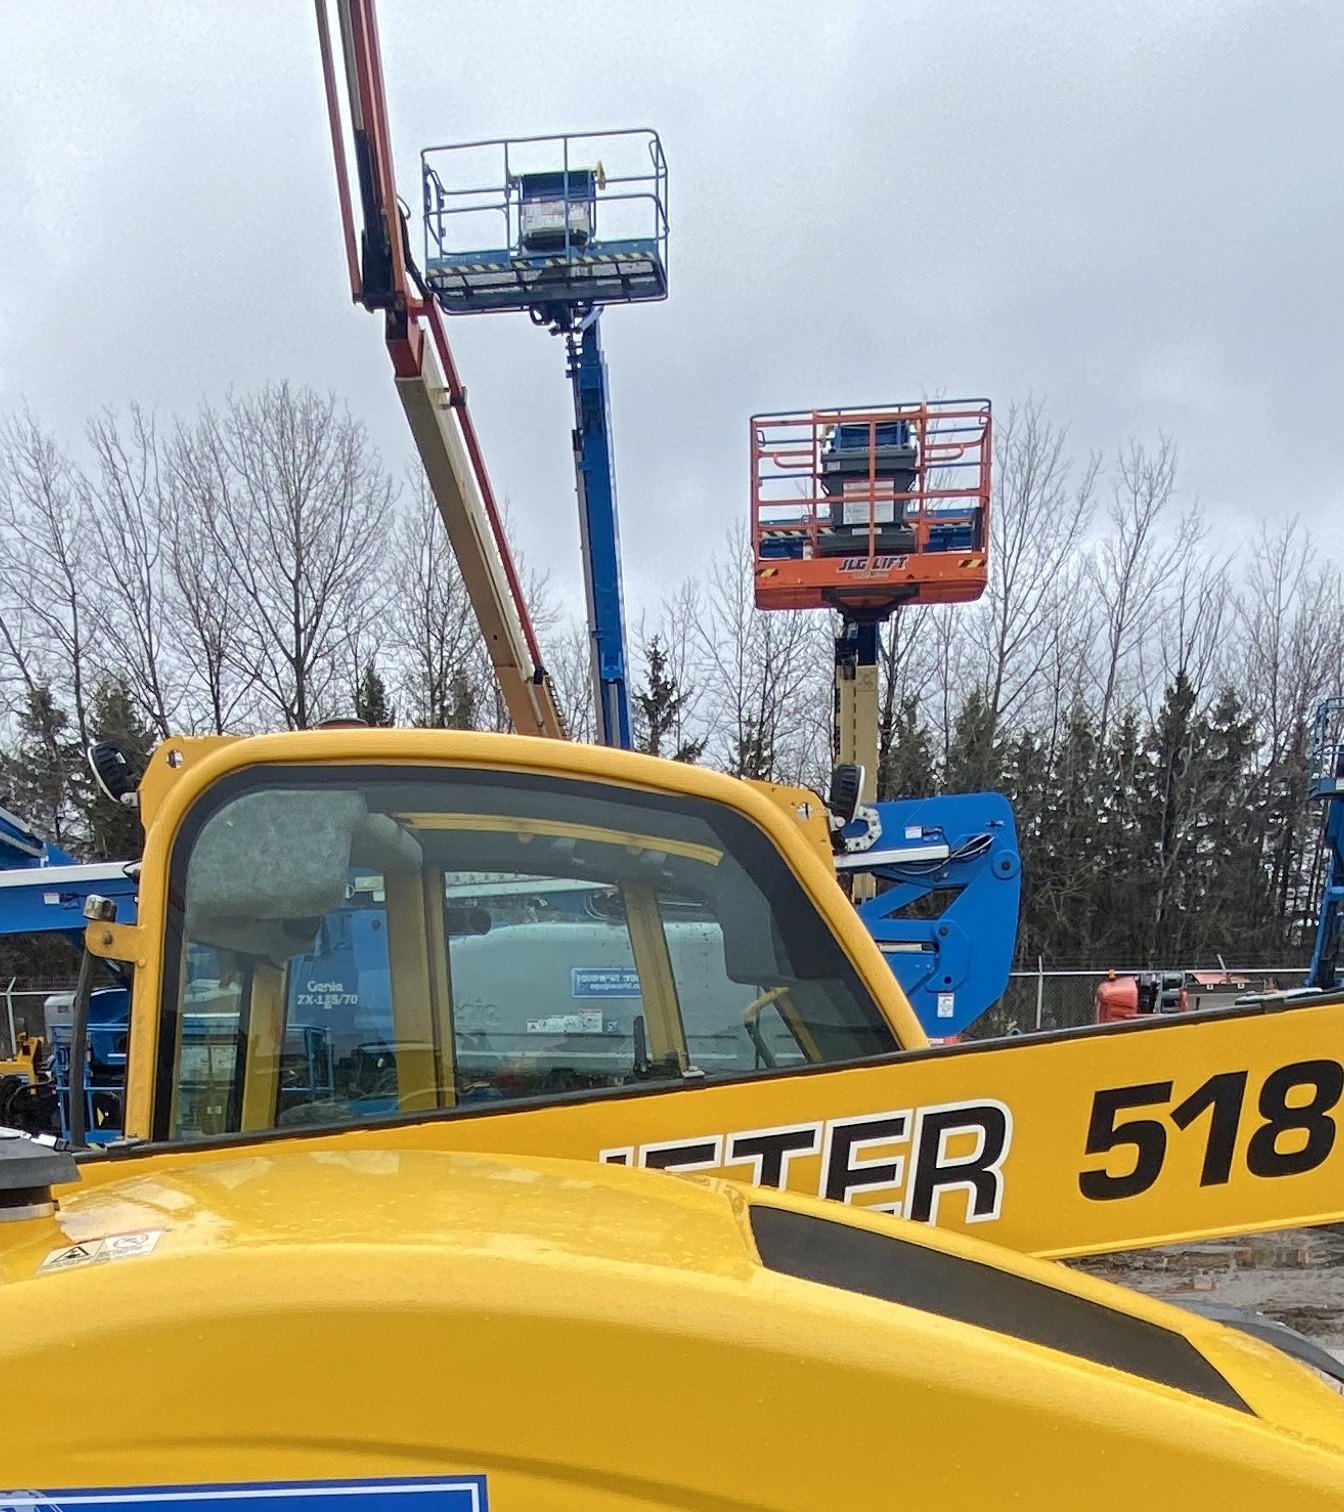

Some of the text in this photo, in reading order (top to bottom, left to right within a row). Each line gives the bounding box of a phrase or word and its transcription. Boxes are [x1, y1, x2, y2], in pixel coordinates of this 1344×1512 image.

[836, 555, 910, 573] JLG LIFT
[306, 979, 345, 993] Genie
[599, 1097, 1014, 1225] TER
